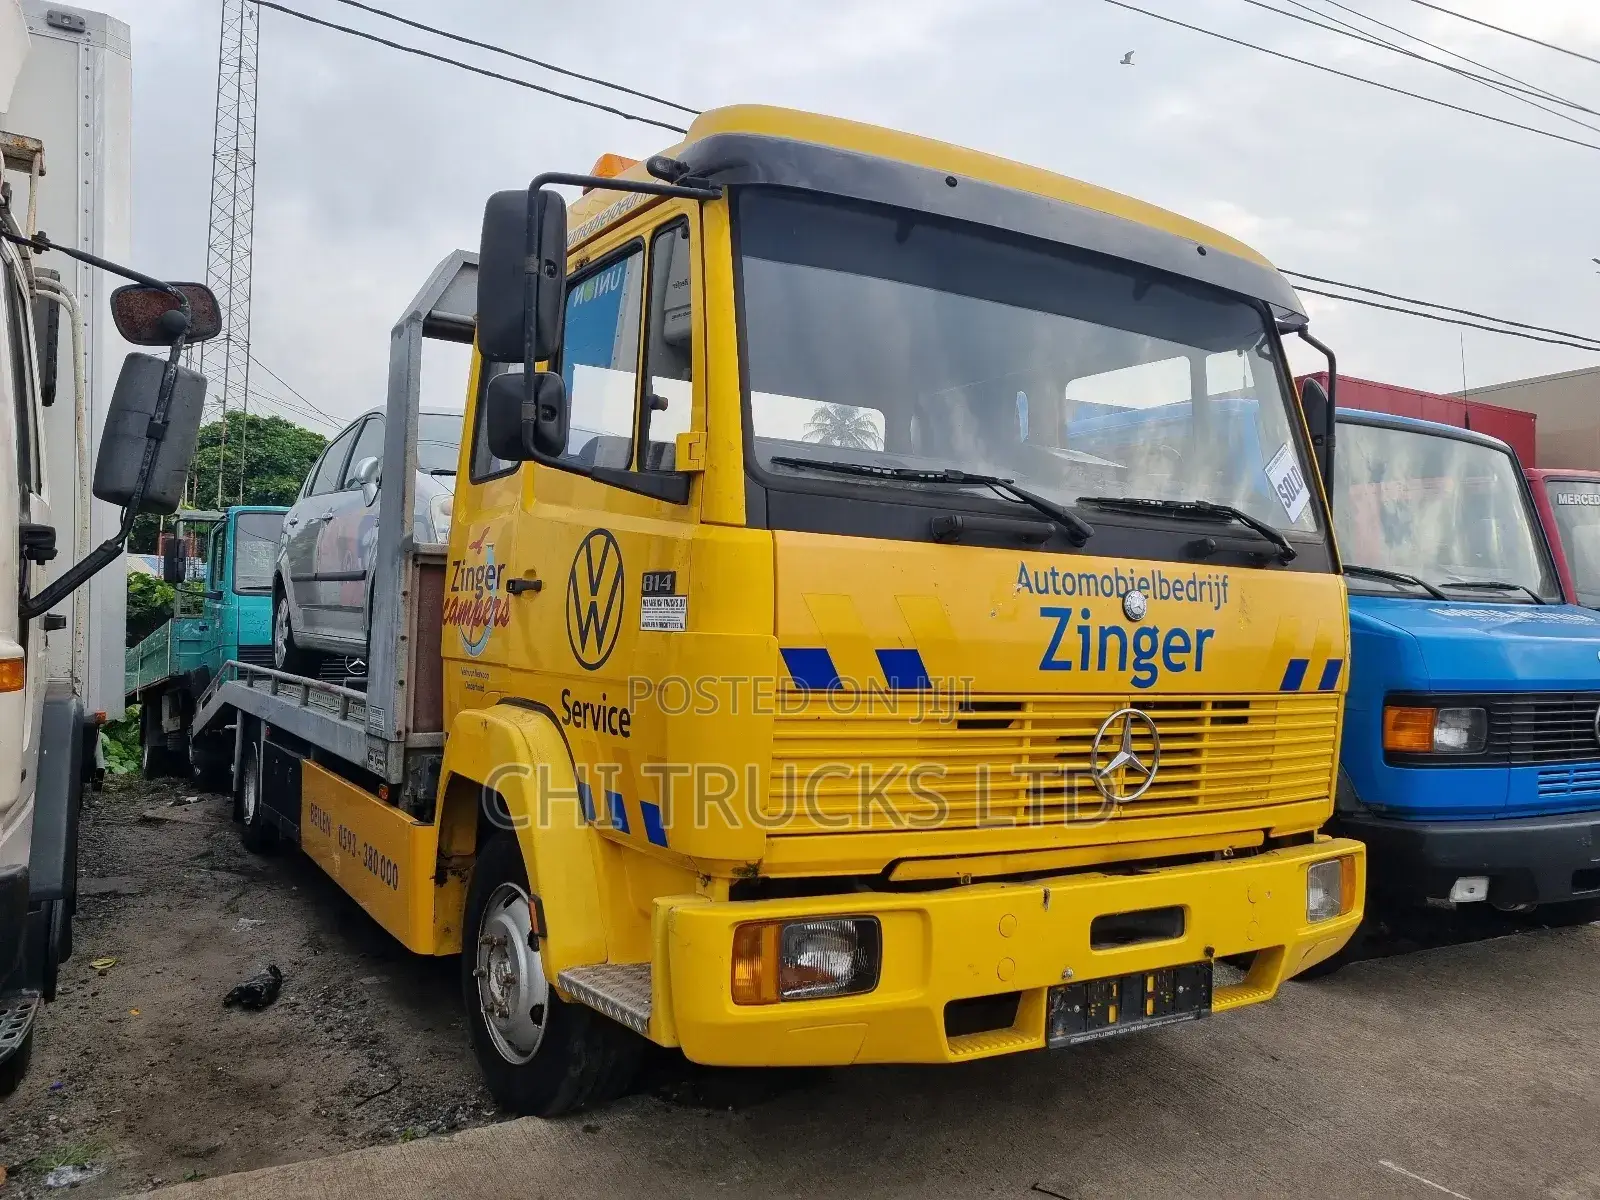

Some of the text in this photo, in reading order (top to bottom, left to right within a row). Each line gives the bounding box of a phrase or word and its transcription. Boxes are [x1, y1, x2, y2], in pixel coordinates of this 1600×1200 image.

[1276, 465, 1305, 509] SOLD
[1557, 493, 1600, 506] MERCED
[450, 558, 506, 601] Zinger
[642, 573, 673, 593] 814
[1016, 560, 1229, 611] Automobielbedrijf
[442, 593, 510, 643] campers
[1038, 606, 1216, 689] Zinger
[560, 688, 632, 738] Service
